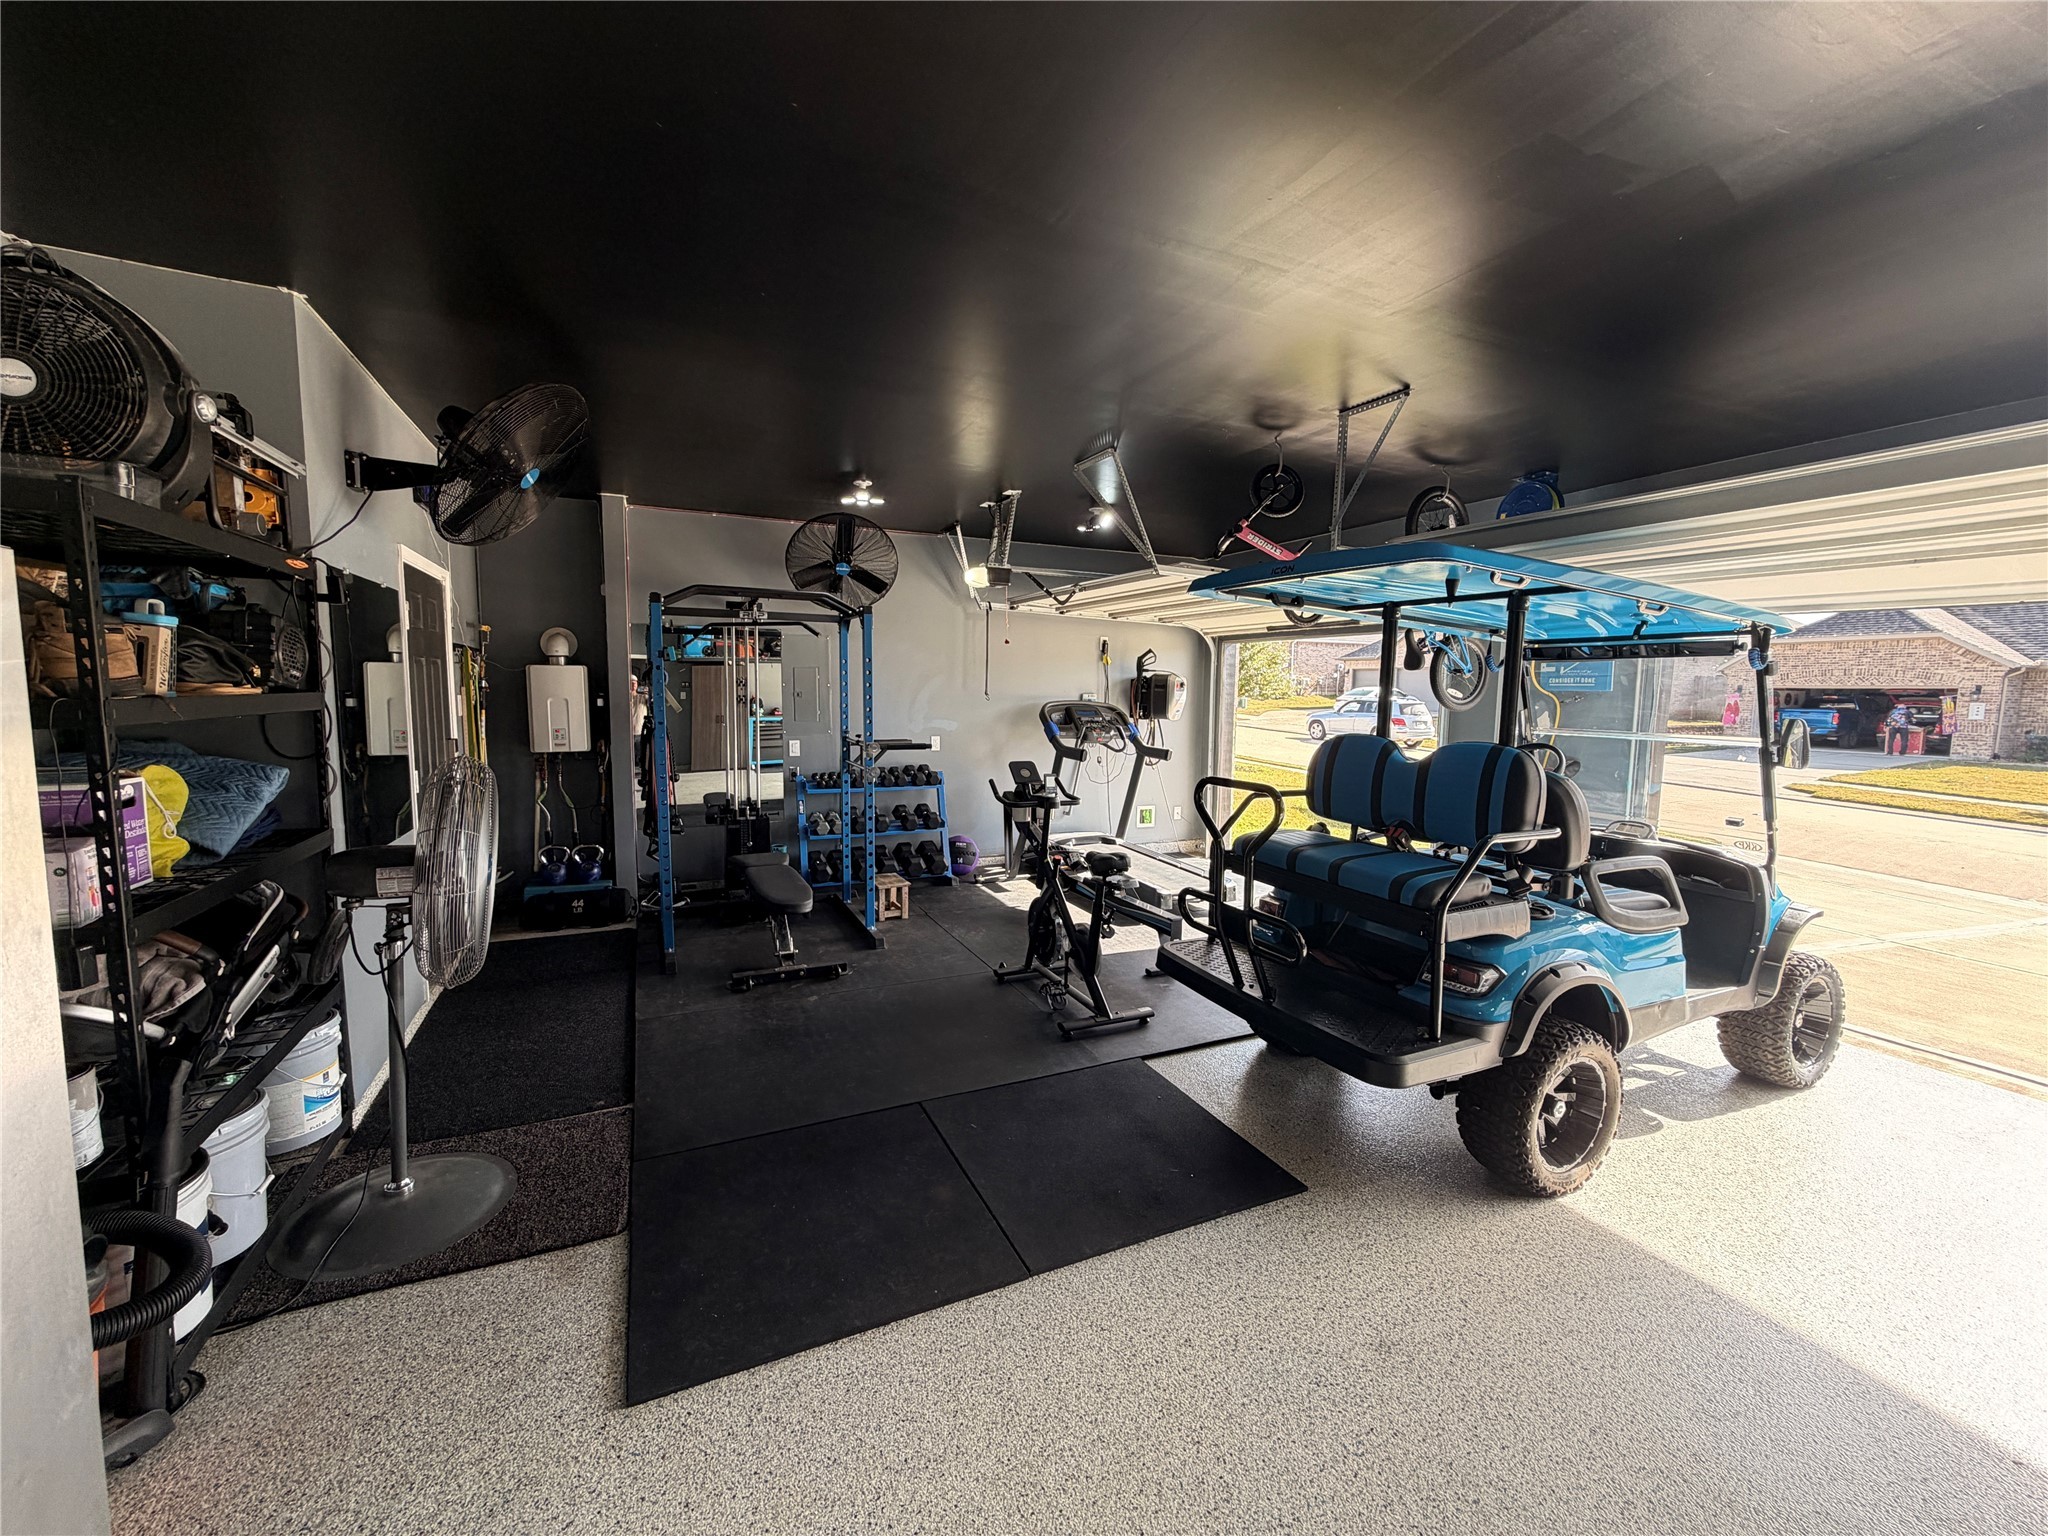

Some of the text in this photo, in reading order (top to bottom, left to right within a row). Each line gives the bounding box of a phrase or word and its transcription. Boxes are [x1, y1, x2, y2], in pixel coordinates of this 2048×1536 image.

[1247, 533, 1283, 555] STRIDER
[1271, 565, 1295, 575] ICON
[571, 899, 584, 908] 44
